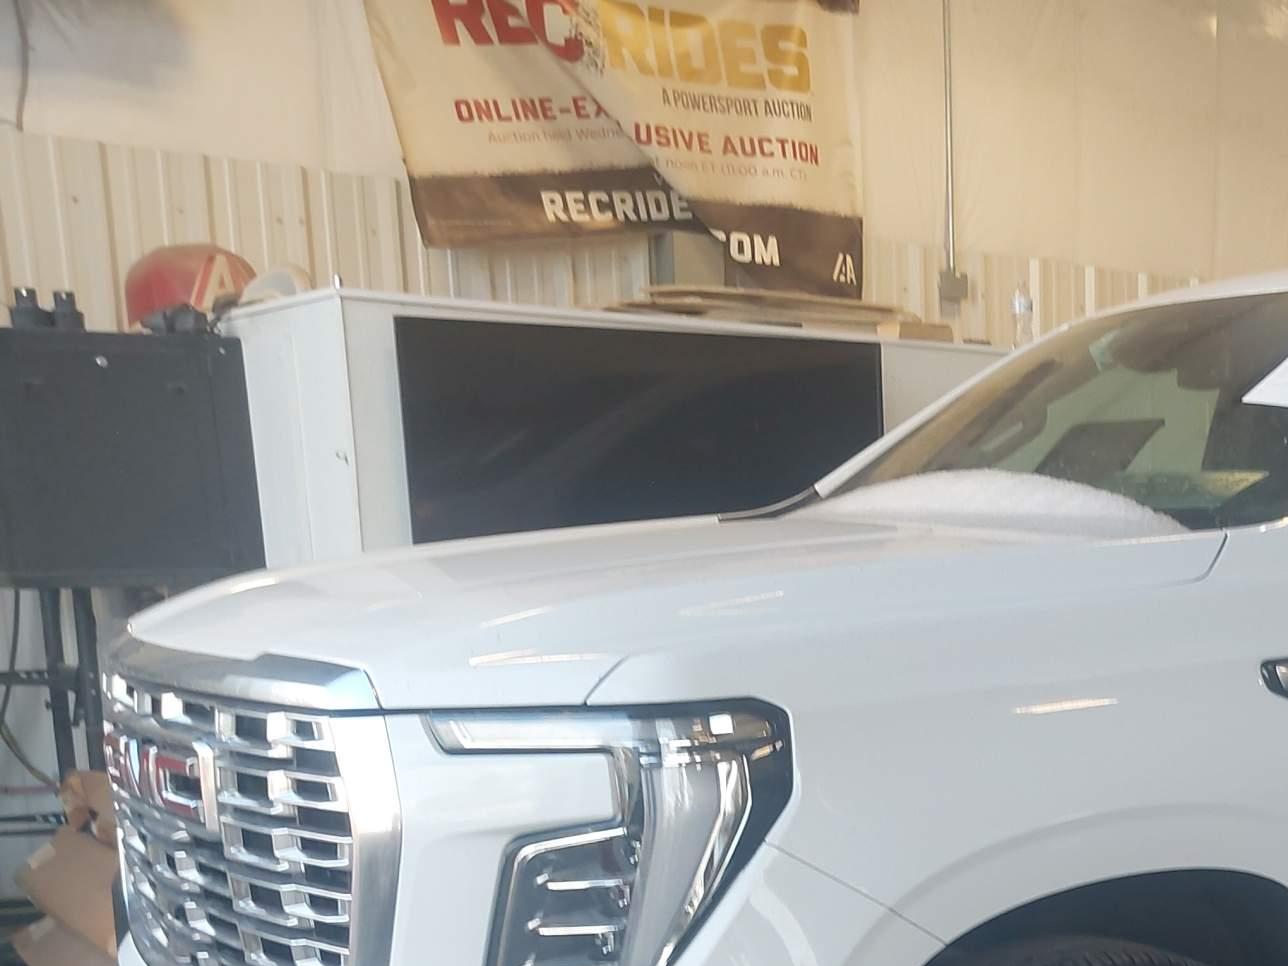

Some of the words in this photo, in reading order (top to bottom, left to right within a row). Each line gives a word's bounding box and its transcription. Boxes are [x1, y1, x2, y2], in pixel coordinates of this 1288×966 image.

[661, 87, 673, 108] A
[672, 90, 759, 116] POWERSPORT
[763, 99, 812, 122] AUCTION
[722, 135, 819, 167] AUCTION
